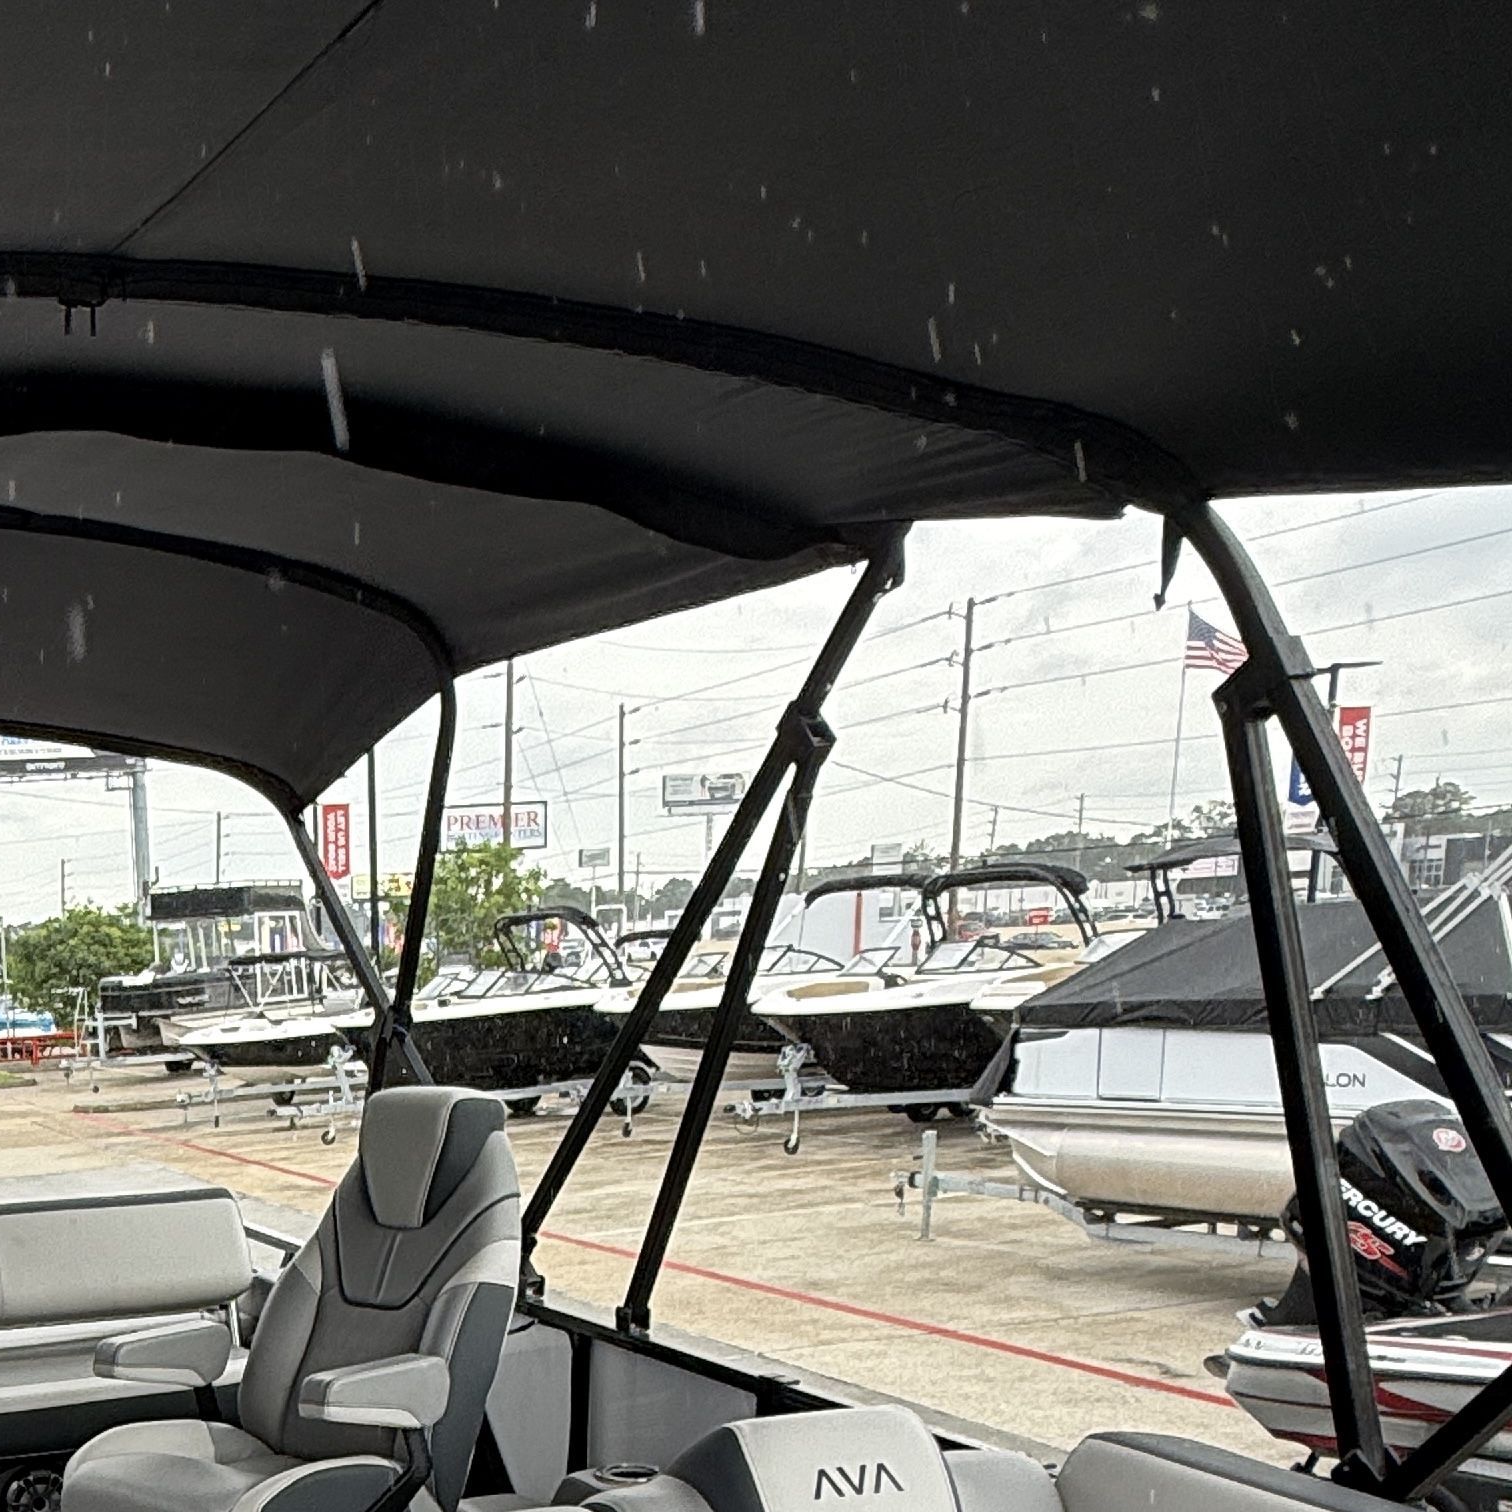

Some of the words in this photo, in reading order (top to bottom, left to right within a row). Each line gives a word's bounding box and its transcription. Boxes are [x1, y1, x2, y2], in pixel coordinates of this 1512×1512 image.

[1354, 718, 1368, 748] WE
[447, 811, 540, 832] PREMER
[1340, 1178, 1428, 1246] ERCURY
[814, 1462, 905, 1500] AVA
